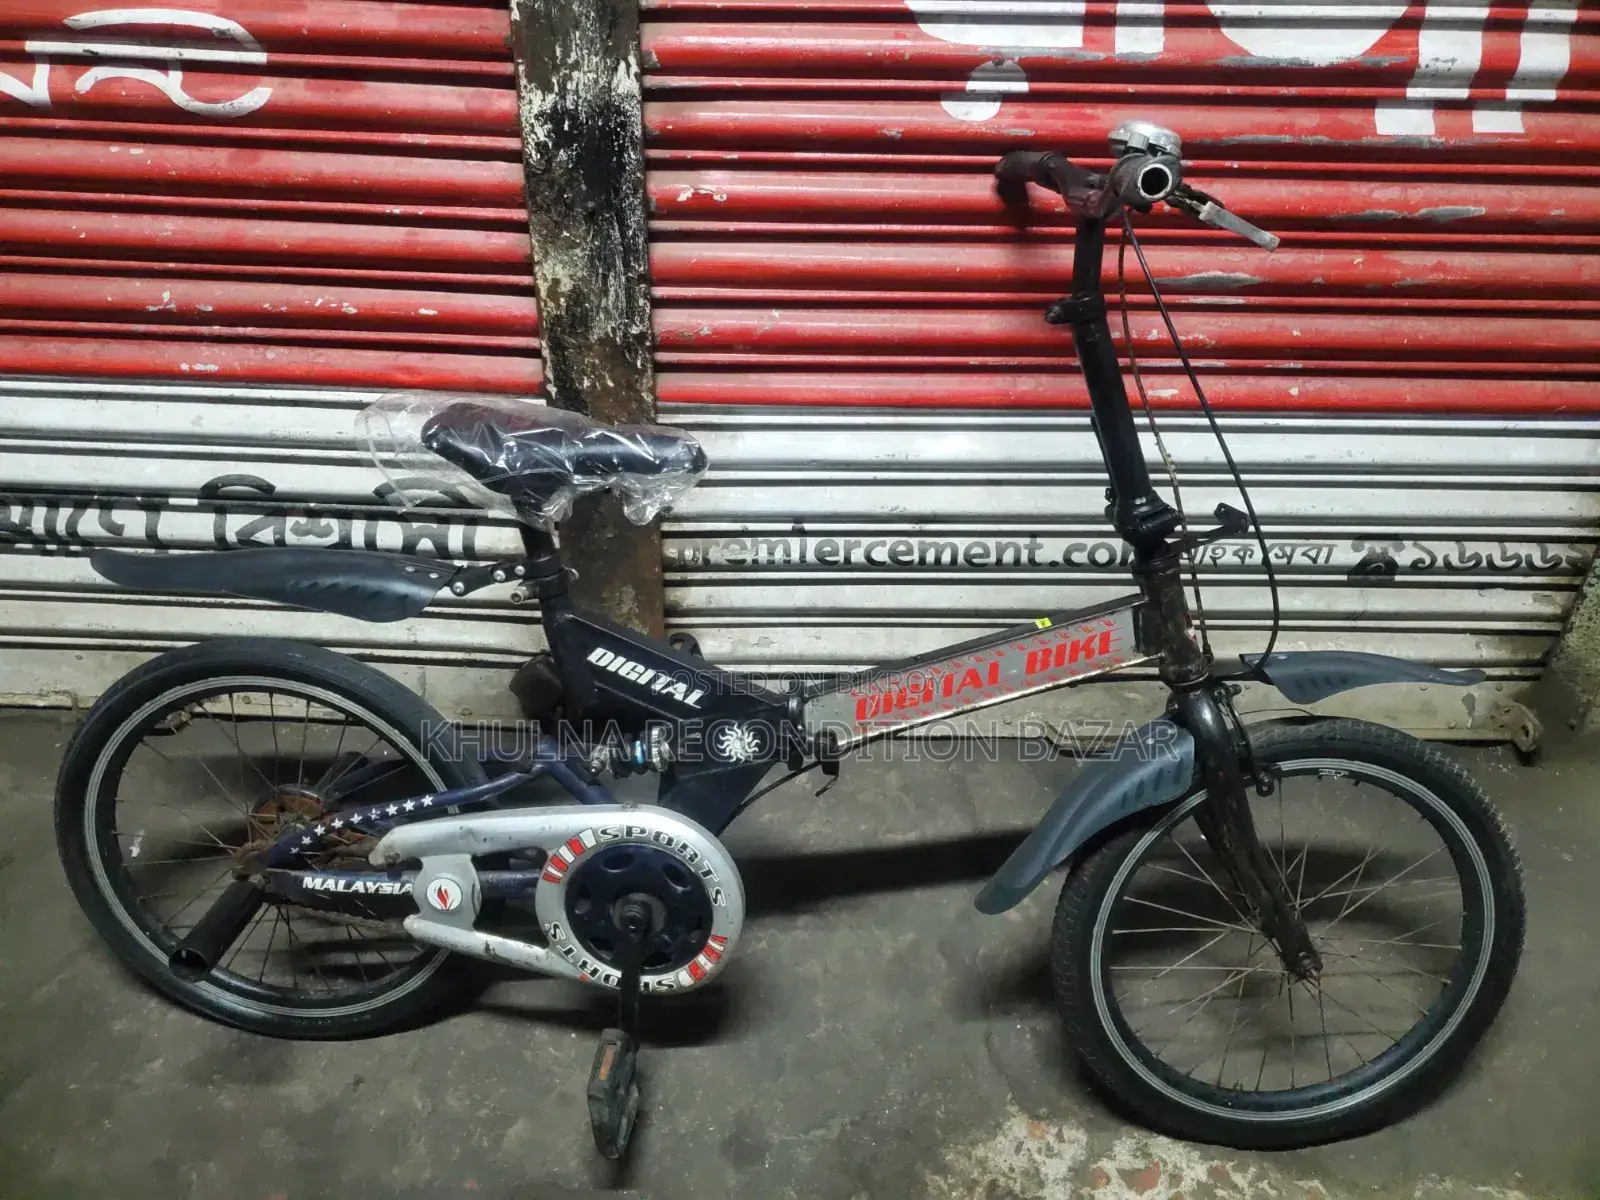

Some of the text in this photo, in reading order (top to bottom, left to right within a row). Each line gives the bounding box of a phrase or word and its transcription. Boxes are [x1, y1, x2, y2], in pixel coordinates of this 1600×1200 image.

[200, 474, 486, 562] বিশ্াসী
[587, 647, 705, 709] DIGITAL
[855, 628, 1123, 721] DIGITAL BIKE
[302, 876, 413, 895] MALAYSIA
[599, 825, 726, 907] SPORTS
